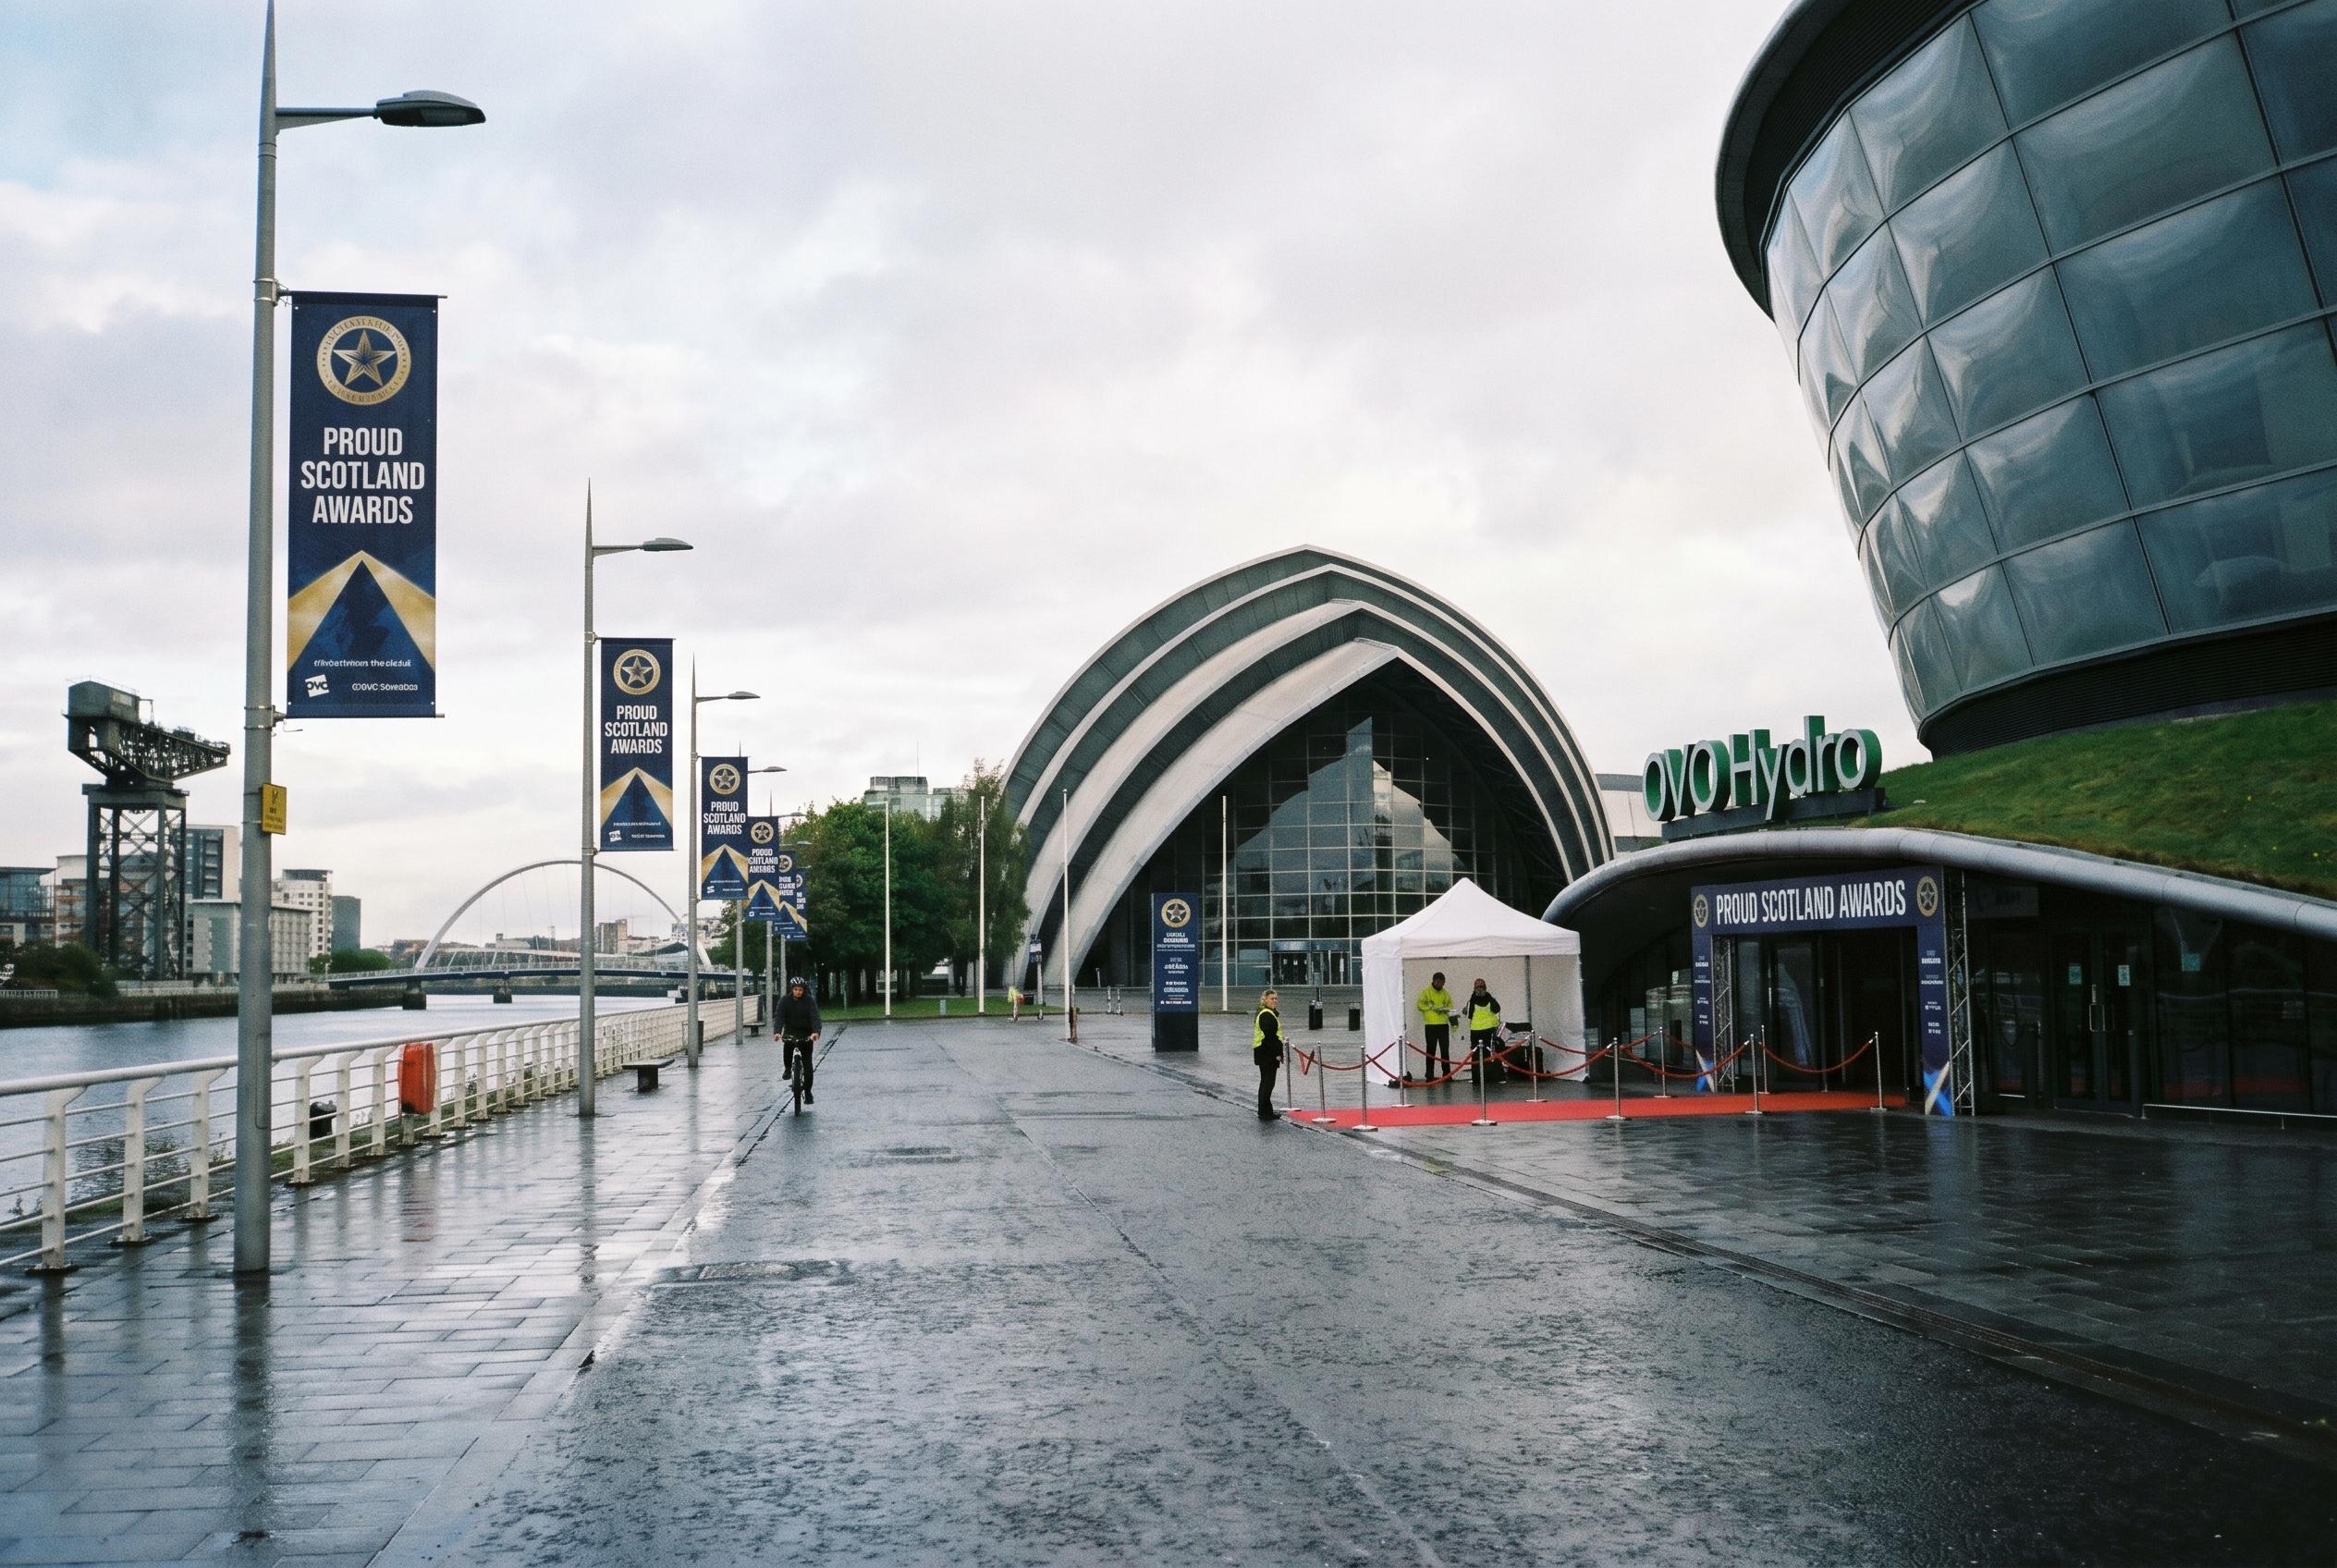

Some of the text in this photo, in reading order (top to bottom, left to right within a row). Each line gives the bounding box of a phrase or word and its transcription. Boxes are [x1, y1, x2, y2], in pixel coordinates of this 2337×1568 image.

[324, 427, 403, 456] PROUD
[300, 460, 425, 490] SCOTLAND
[312, 496, 414, 524] AWARDS
[617, 705, 657, 720] PROUD
[605, 721, 668, 737] SCOTLAND
[610, 739, 663, 754] AWARDS
[1729, 716, 1882, 821] Hydro
[711, 802, 739, 812] PROUD
[703, 813, 746, 824] SCOTLAND
[1716, 879, 1906, 925] PROUD SCOTLAND AWARDS
